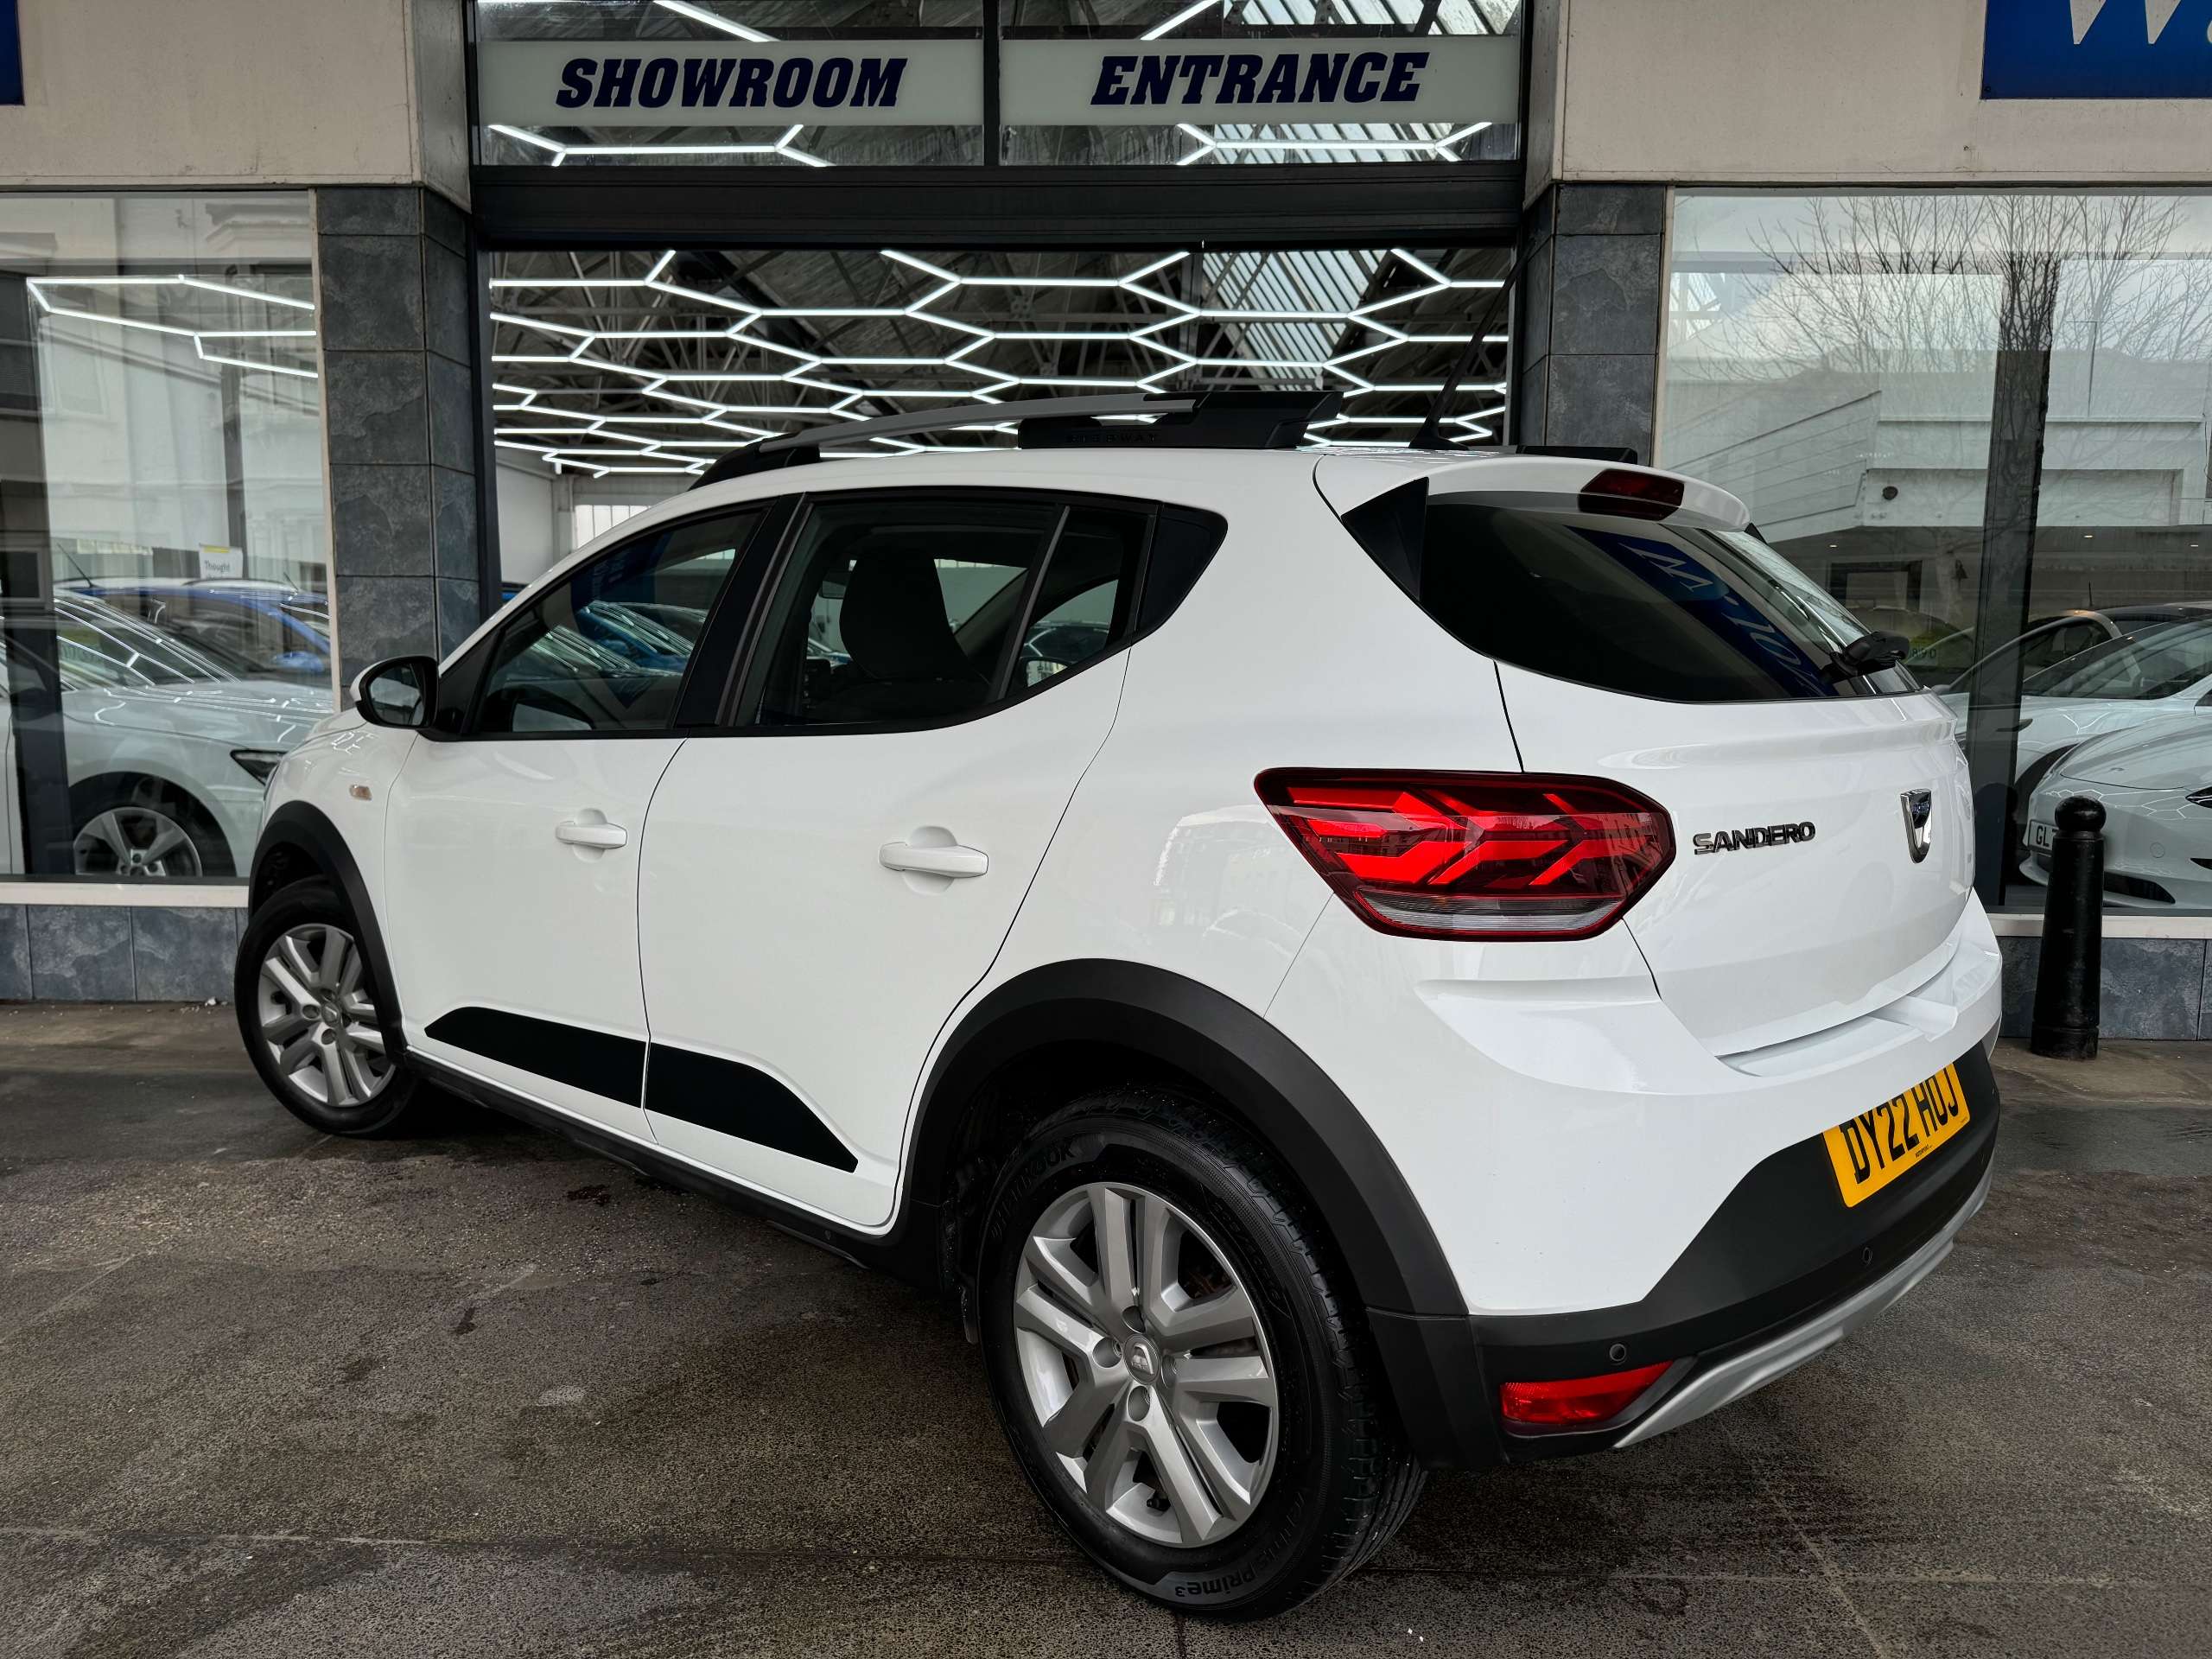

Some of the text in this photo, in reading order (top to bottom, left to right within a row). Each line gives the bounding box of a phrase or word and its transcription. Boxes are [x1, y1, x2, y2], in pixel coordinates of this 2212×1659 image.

[556, 52, 1430, 108] SHOWROOM ENTRANCE
[1693, 821, 1816, 855] SANDERO
[1839, 1093, 1920, 1185] DY22
